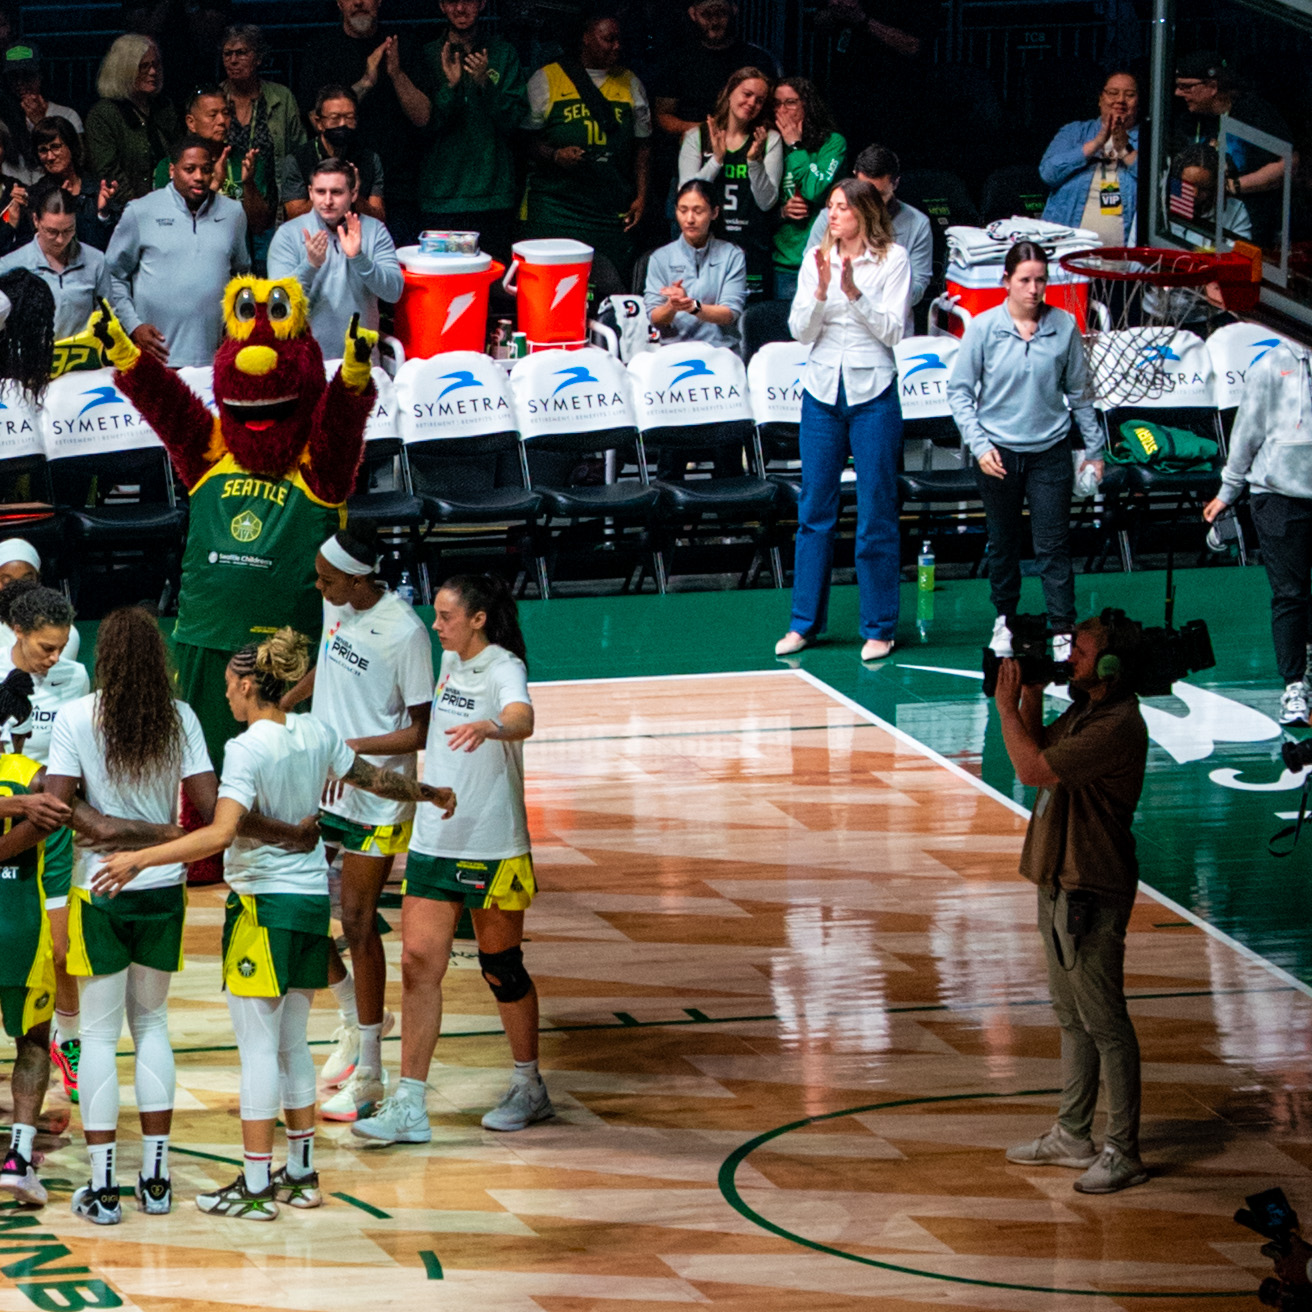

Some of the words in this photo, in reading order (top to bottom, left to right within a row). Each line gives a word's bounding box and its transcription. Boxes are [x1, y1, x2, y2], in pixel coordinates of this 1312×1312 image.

[722, 183, 739, 211] 5
[1101, 193, 1121, 207] VIP
[528, 391, 625, 414] SYMETRA
[644, 383, 741, 406] SYMETRA
[412, 396, 509, 419] SYMETRA
[220, 478, 288, 508] SEATTLE
[331, 641, 370, 671] PRIDE
[441, 693, 476, 710] PRIDE
